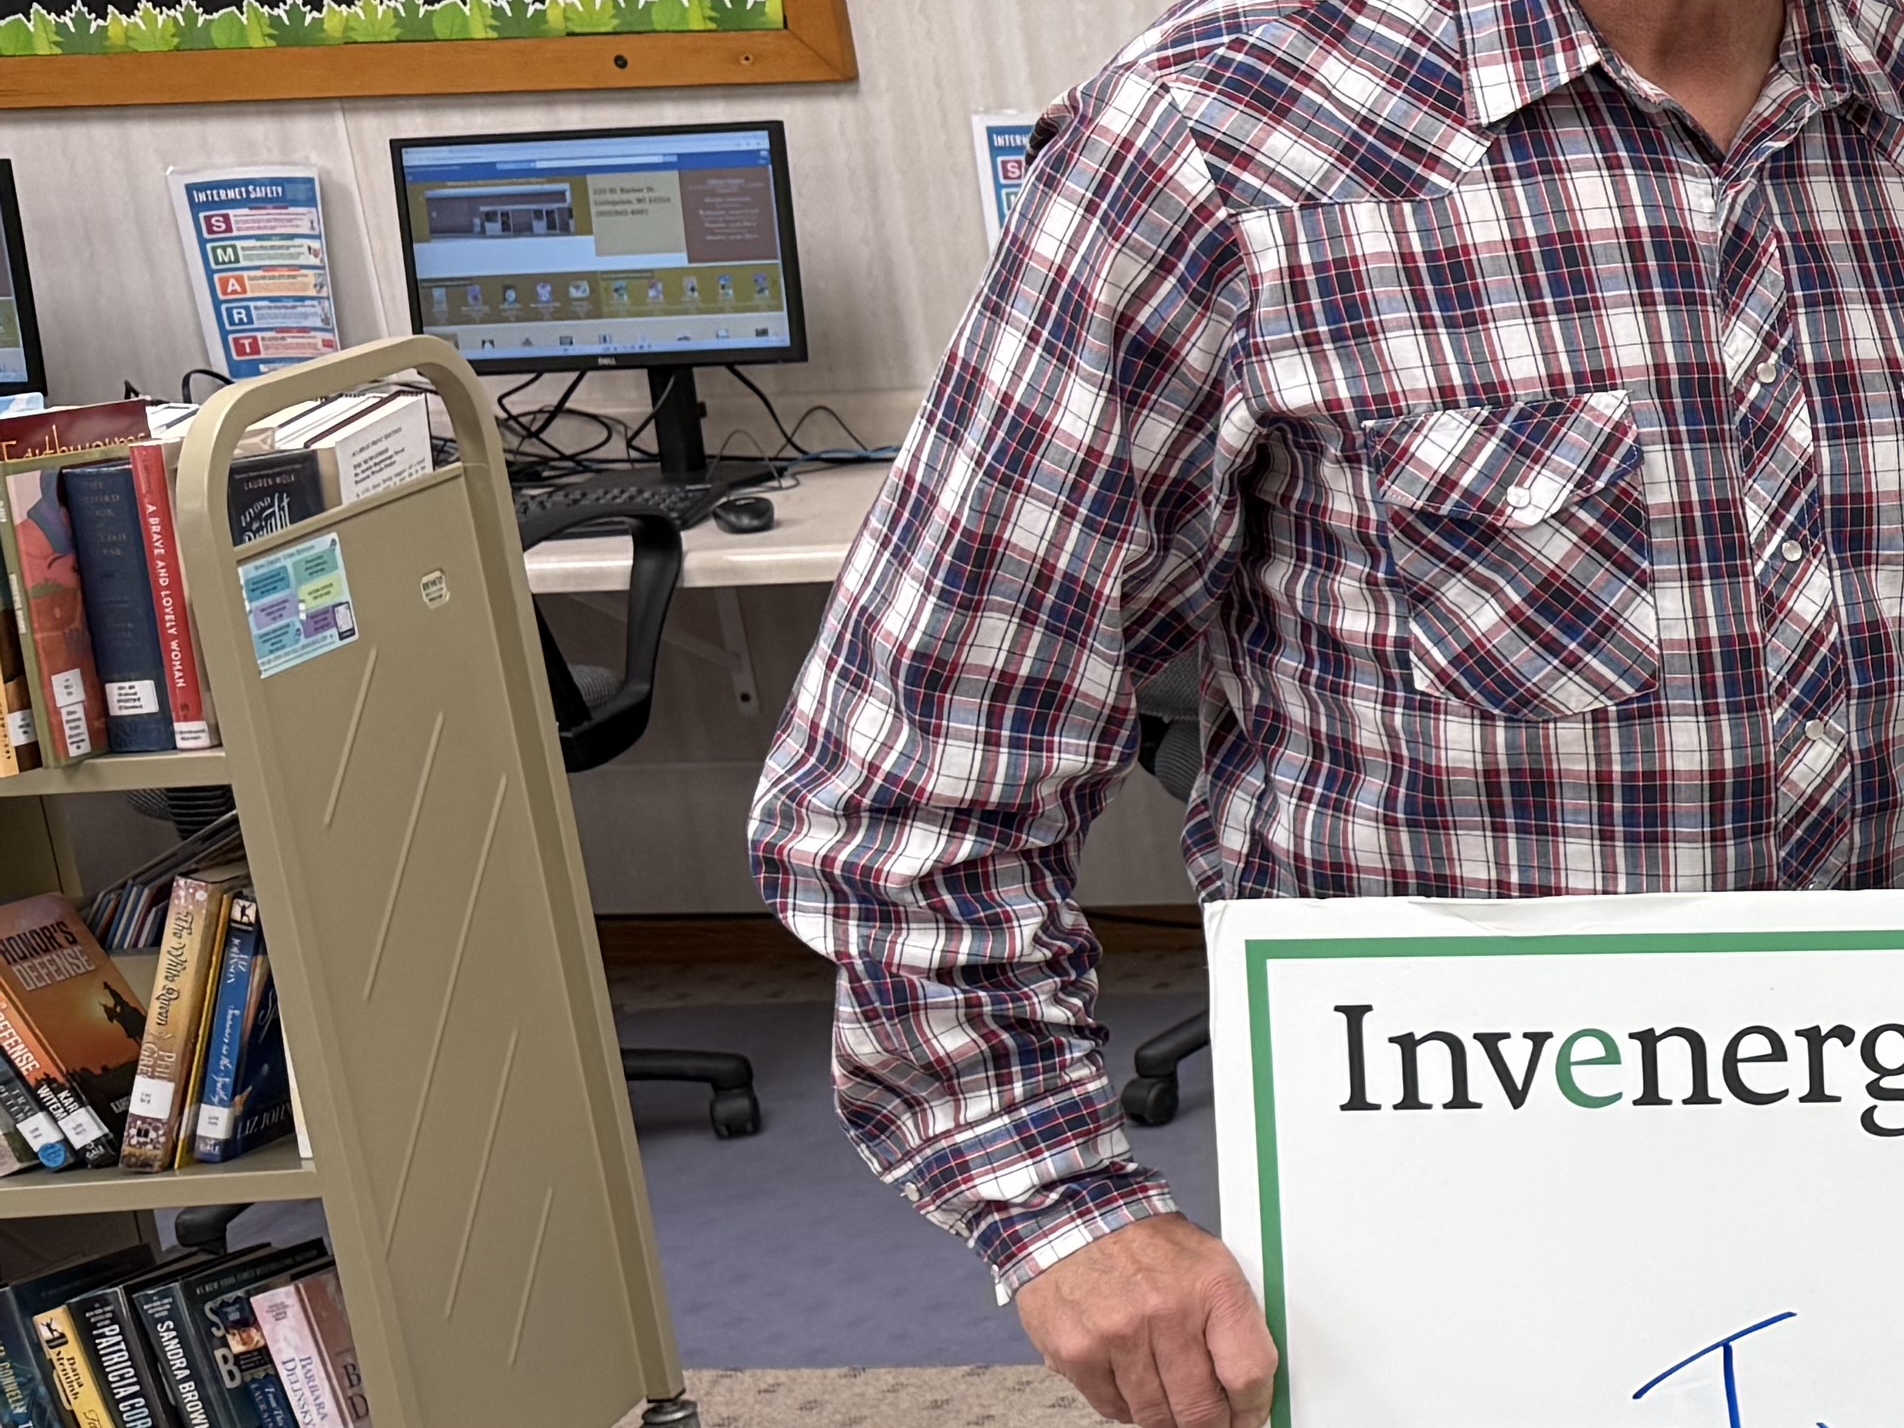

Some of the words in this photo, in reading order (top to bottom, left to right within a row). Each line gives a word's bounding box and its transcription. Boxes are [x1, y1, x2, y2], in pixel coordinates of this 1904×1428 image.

[227, 278, 242, 293] A
[232, 309, 248, 324] R
[239, 340, 254, 353] T
[152, 518, 165, 557] BRAVE
[157, 559, 169, 584] AND
[161, 588, 178, 635] LOVELY
[171, 639, 187, 688] WOMAN
[1, 921, 76, 964] HONOR'S
[11, 946, 96, 991] DEFENSE
[92, 1323, 141, 1399] PATRICIA
[157, 1320, 192, 1380] SANDRA
